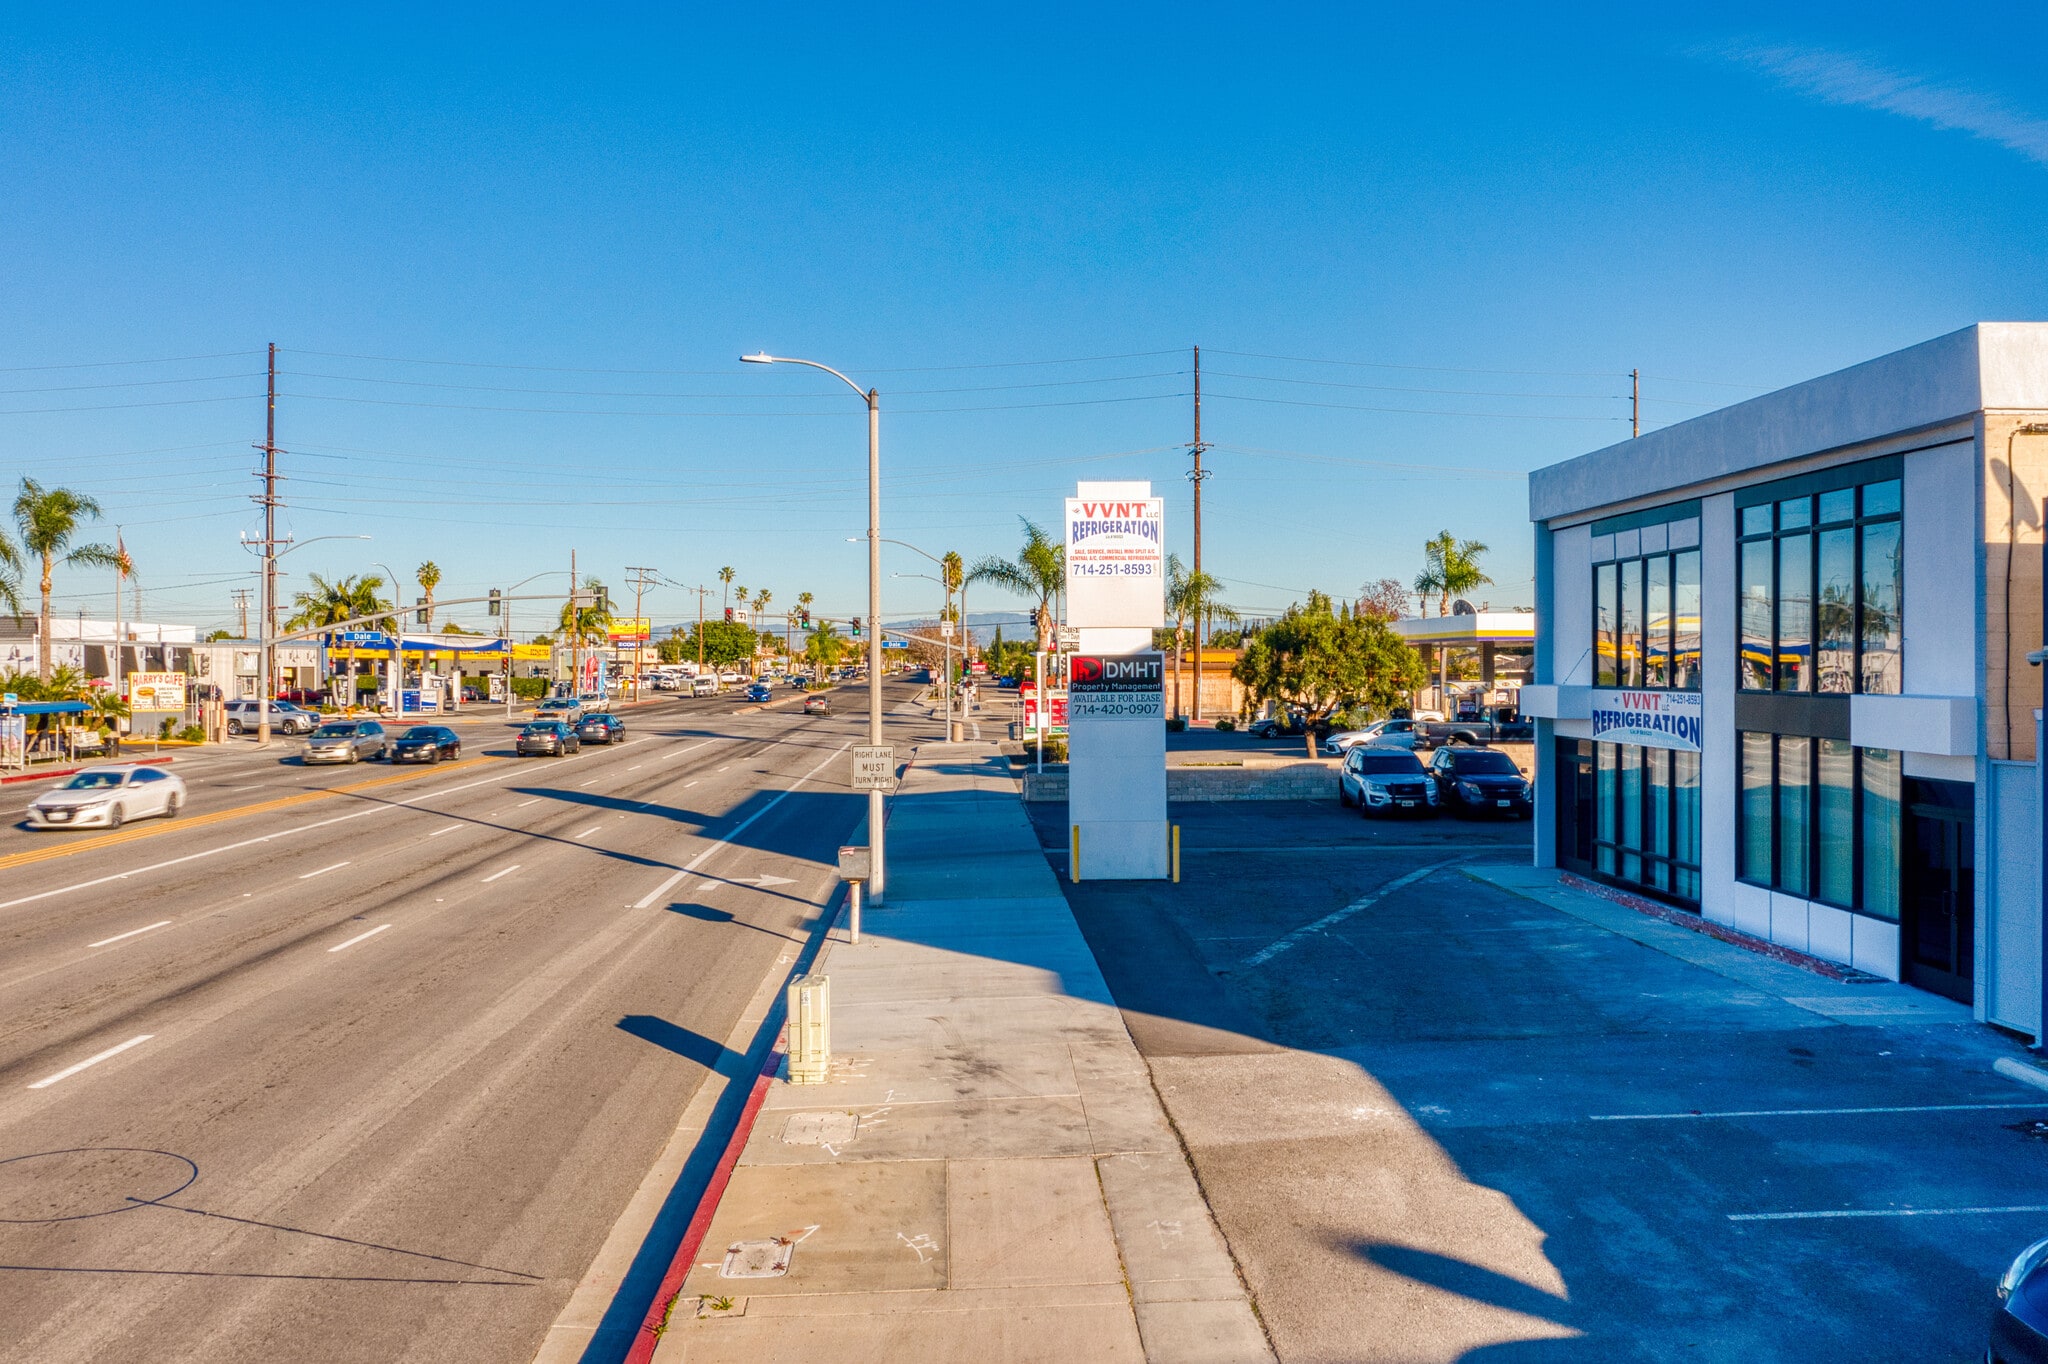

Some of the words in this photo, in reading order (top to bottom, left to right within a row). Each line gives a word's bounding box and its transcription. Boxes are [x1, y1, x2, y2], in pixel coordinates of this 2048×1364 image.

[1082, 503, 1146, 518] VVNT
[1072, 520, 1158, 545] REFRIGERATION
[1073, 563, 1151, 575] 714-251-8593
[1106, 661, 1160, 678] DMHT
[133, 674, 163, 687] HARRY'S
[165, 674, 183, 687] CAFE
[1072, 683, 1110, 692] Property
[1112, 683, 1160, 692] Management
[1073, 694, 1116, 703] AVAILABLE
[1118, 694, 1134, 703] FOR
[1136, 694, 1160, 703] LEASE
[1622, 692, 1661, 710] VVNT
[1666, 694, 1700, 705] 714-251-8593
[1074, 704, 1159, 715] 714-420-0907
[1592, 710, 1700, 748] REFRIGERATION
[862, 763, 884, 771] MUST
